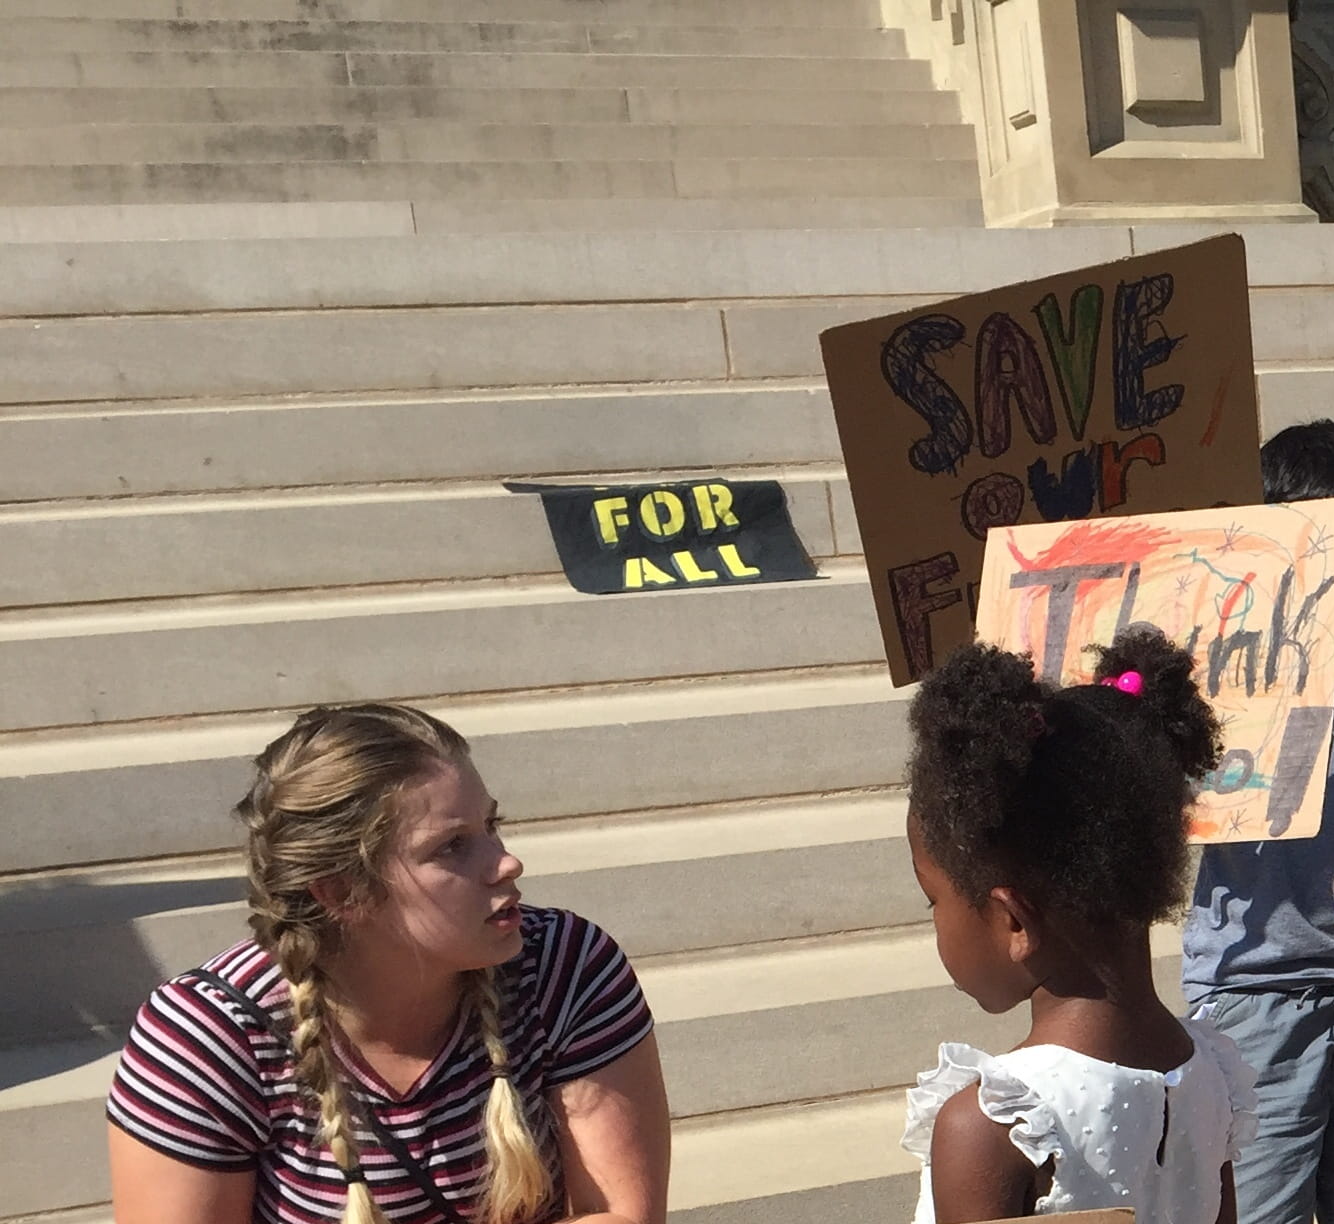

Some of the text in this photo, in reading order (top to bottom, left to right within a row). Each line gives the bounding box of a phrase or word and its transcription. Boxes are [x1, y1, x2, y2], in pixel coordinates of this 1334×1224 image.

[880, 273, 1186, 477] SAVE
[593, 484, 740, 544] FOR
[624, 544, 761, 588] ALL
